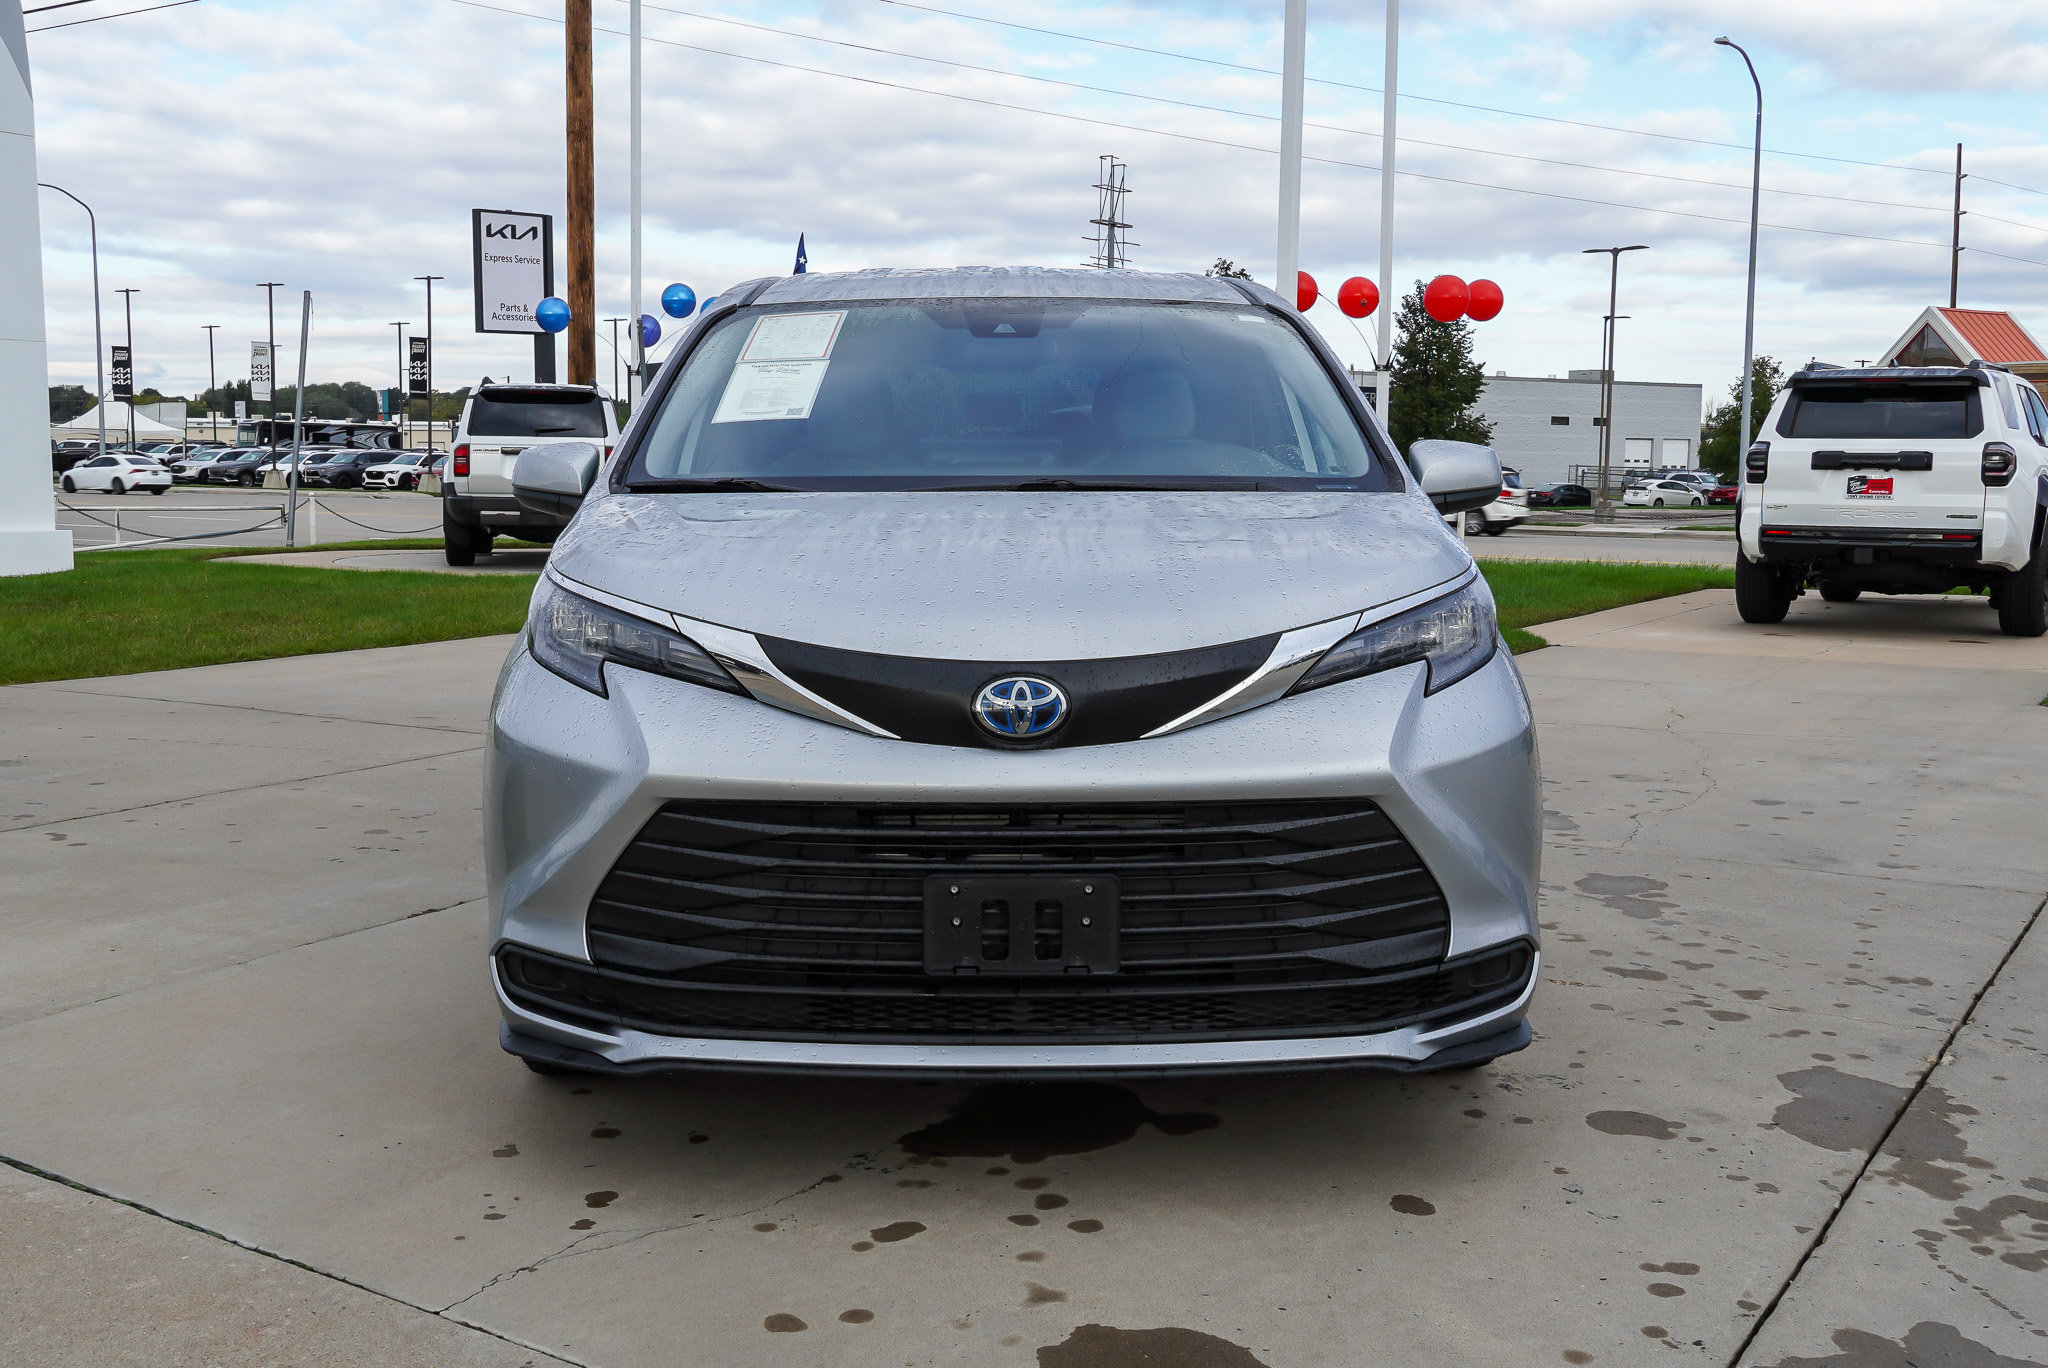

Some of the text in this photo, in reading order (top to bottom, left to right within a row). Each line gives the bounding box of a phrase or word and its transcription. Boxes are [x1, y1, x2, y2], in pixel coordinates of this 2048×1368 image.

[486, 223, 538, 241] KIA
[484, 253, 541, 265] Express Service
[500, 303, 529, 313] Parts &
[491, 312, 537, 322] Accessories
